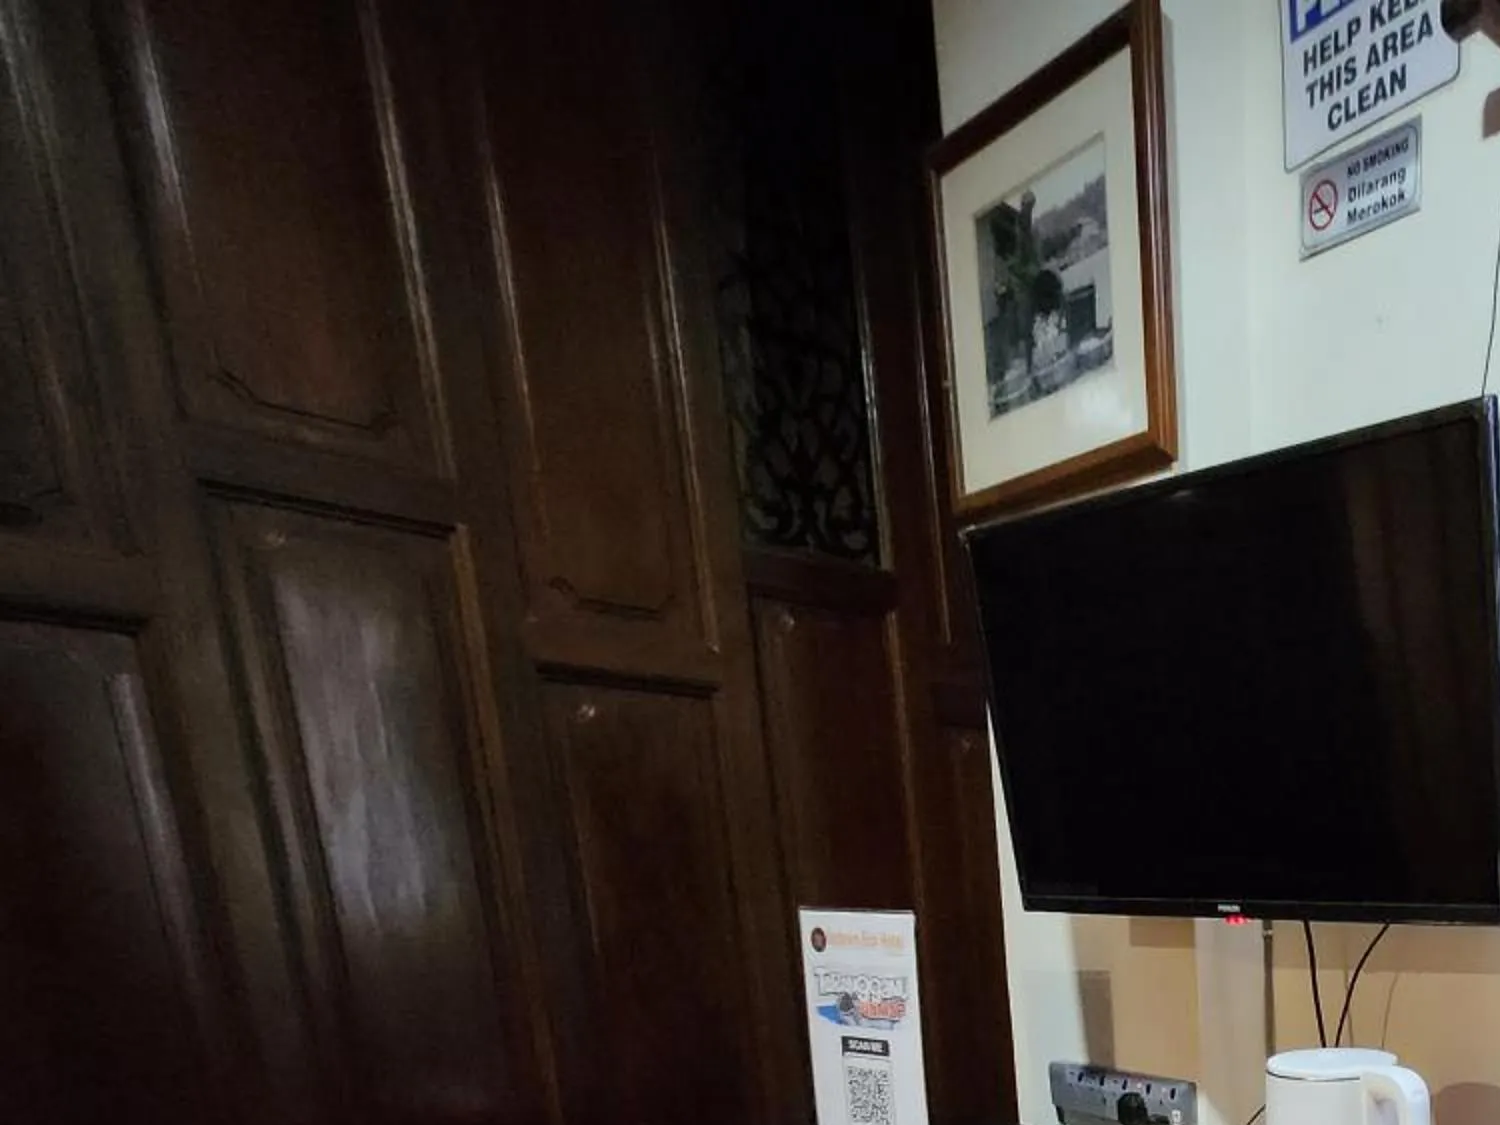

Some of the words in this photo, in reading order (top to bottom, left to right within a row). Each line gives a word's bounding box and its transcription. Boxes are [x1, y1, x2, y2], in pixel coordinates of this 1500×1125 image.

[1303, 17, 1361, 76] HELP
[1305, 57, 1357, 109] THIS
[1365, 12, 1433, 74] AREA
[1327, 64, 1407, 131] CLEAN
[1347, 162, 1361, 177] NO
[1363, 137, 1409, 172] SMOKING
[1347, 167, 1406, 203] Dilarang
